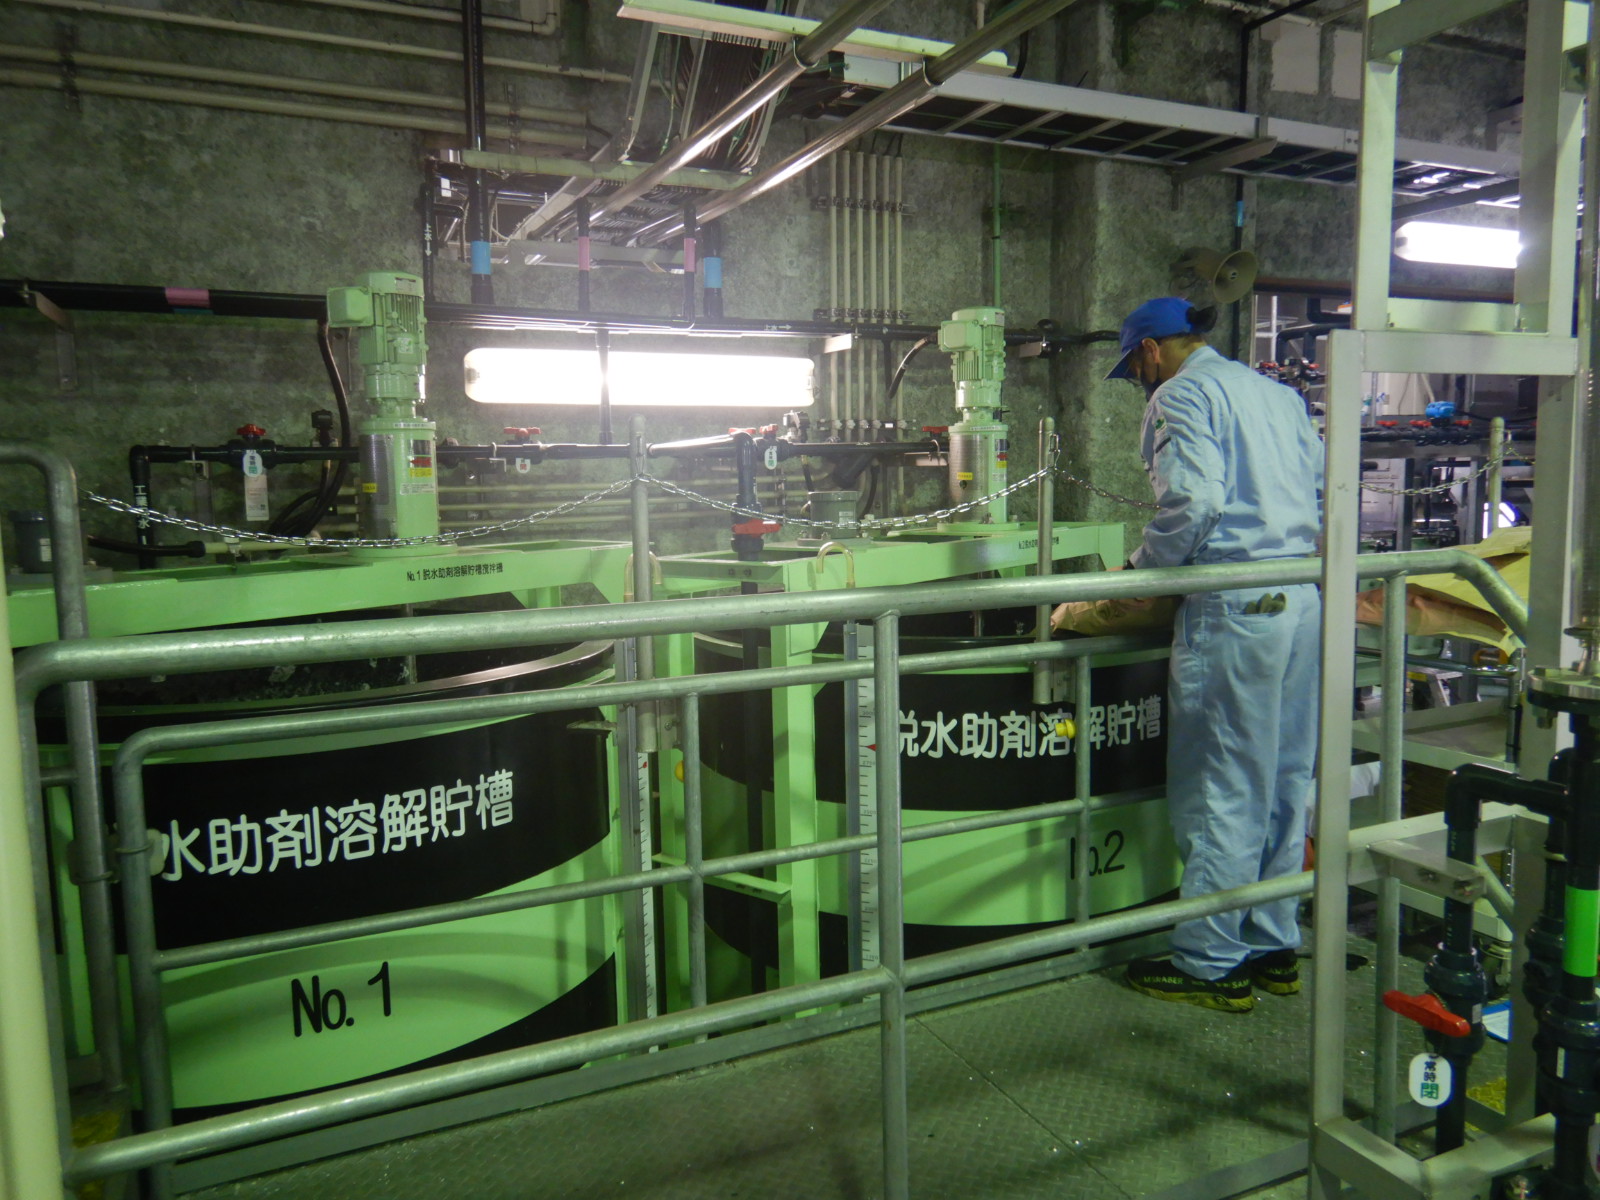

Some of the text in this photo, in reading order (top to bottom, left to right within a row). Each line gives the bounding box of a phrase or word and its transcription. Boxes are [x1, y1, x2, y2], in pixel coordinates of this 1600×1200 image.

[134, 485, 150, 529] 工業水
[161, 768, 514, 882] 水助剤溶解貯槽
